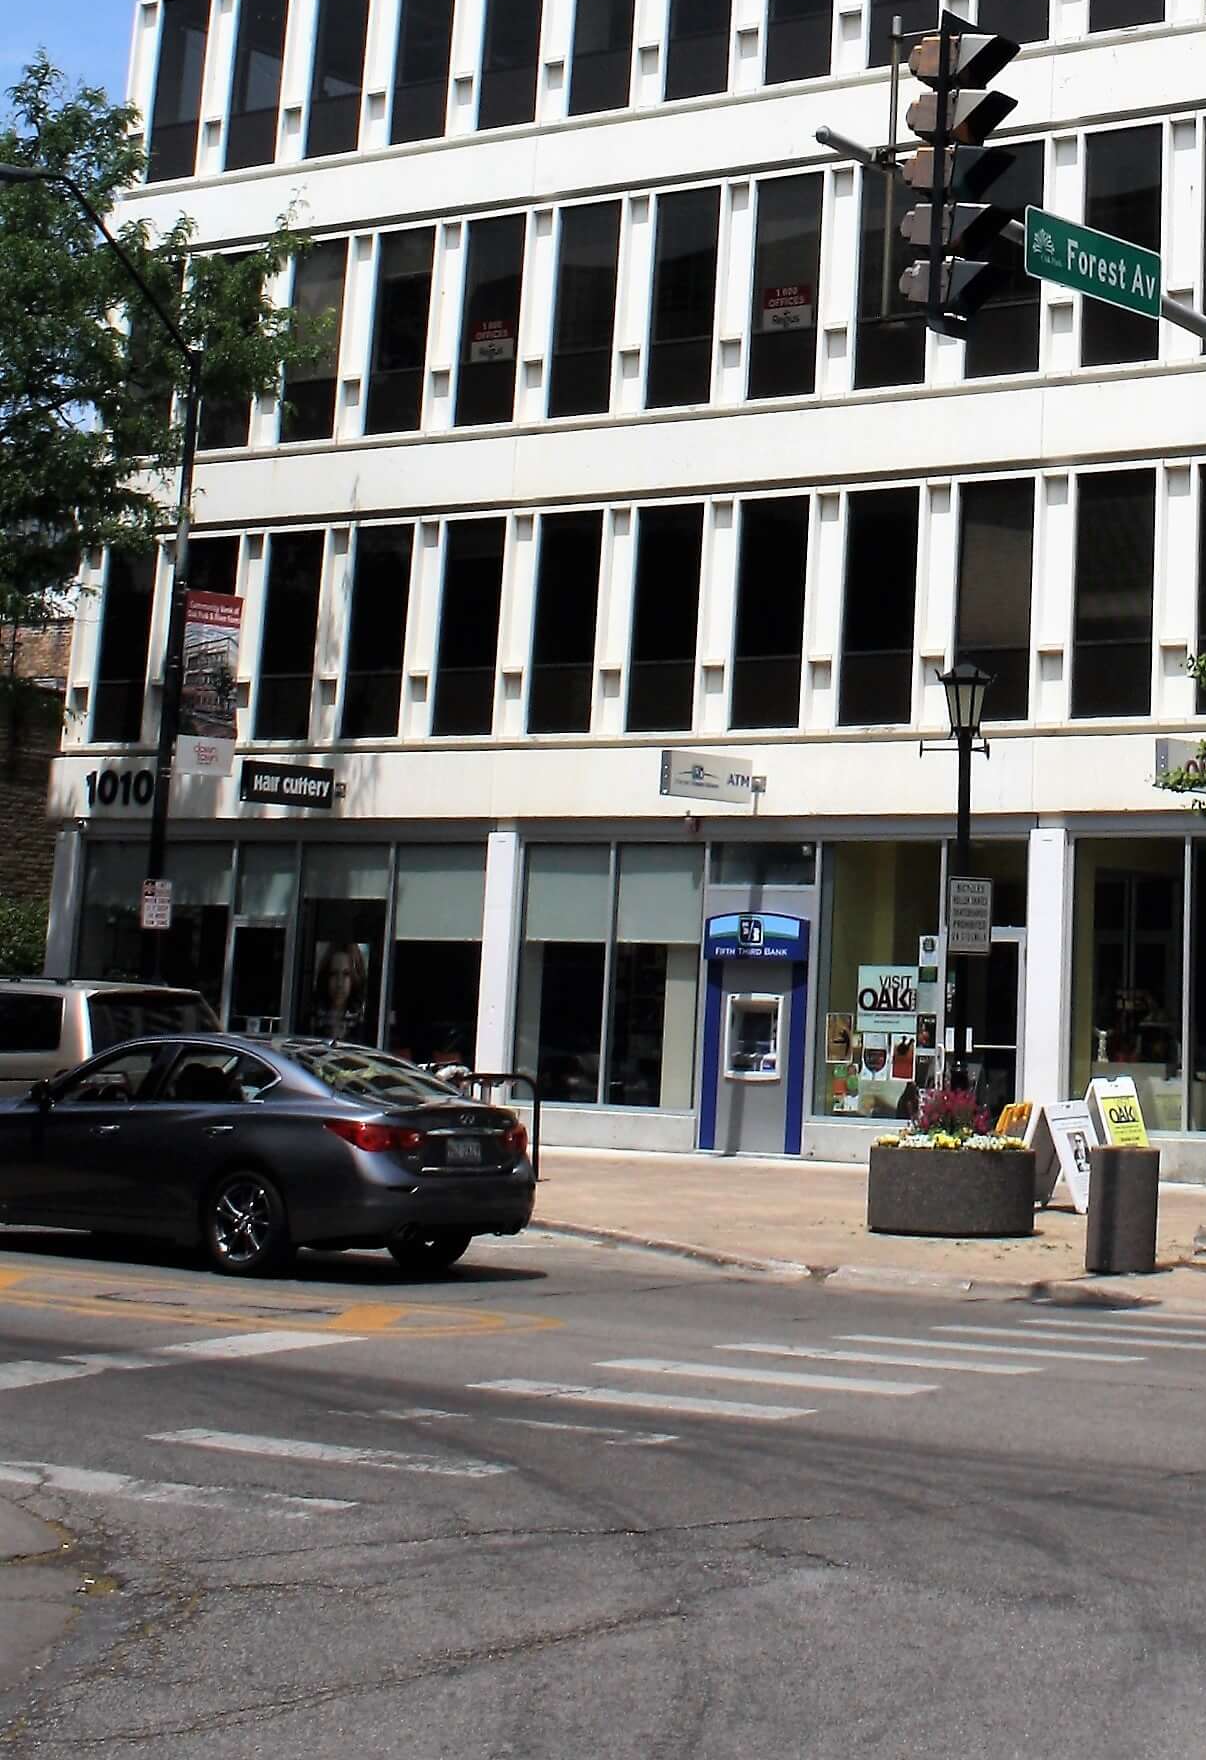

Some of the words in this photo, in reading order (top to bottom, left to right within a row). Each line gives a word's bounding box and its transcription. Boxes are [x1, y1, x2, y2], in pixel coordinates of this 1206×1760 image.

[1067, 238, 1126, 289] Forest
[1132, 264, 1156, 300] Av
[86, 769, 155, 808] 1010
[253, 775, 281, 793] Hair
[727, 773, 750, 788] ATM
[715, 946, 736, 956] FIFTH
[738, 947, 762, 956] THIRD
[763, 946, 788, 956] BANK
[879, 975, 913, 990] VISIT
[859, 988, 912, 1011] OAK
[1109, 1105, 1138, 1124] OAK
